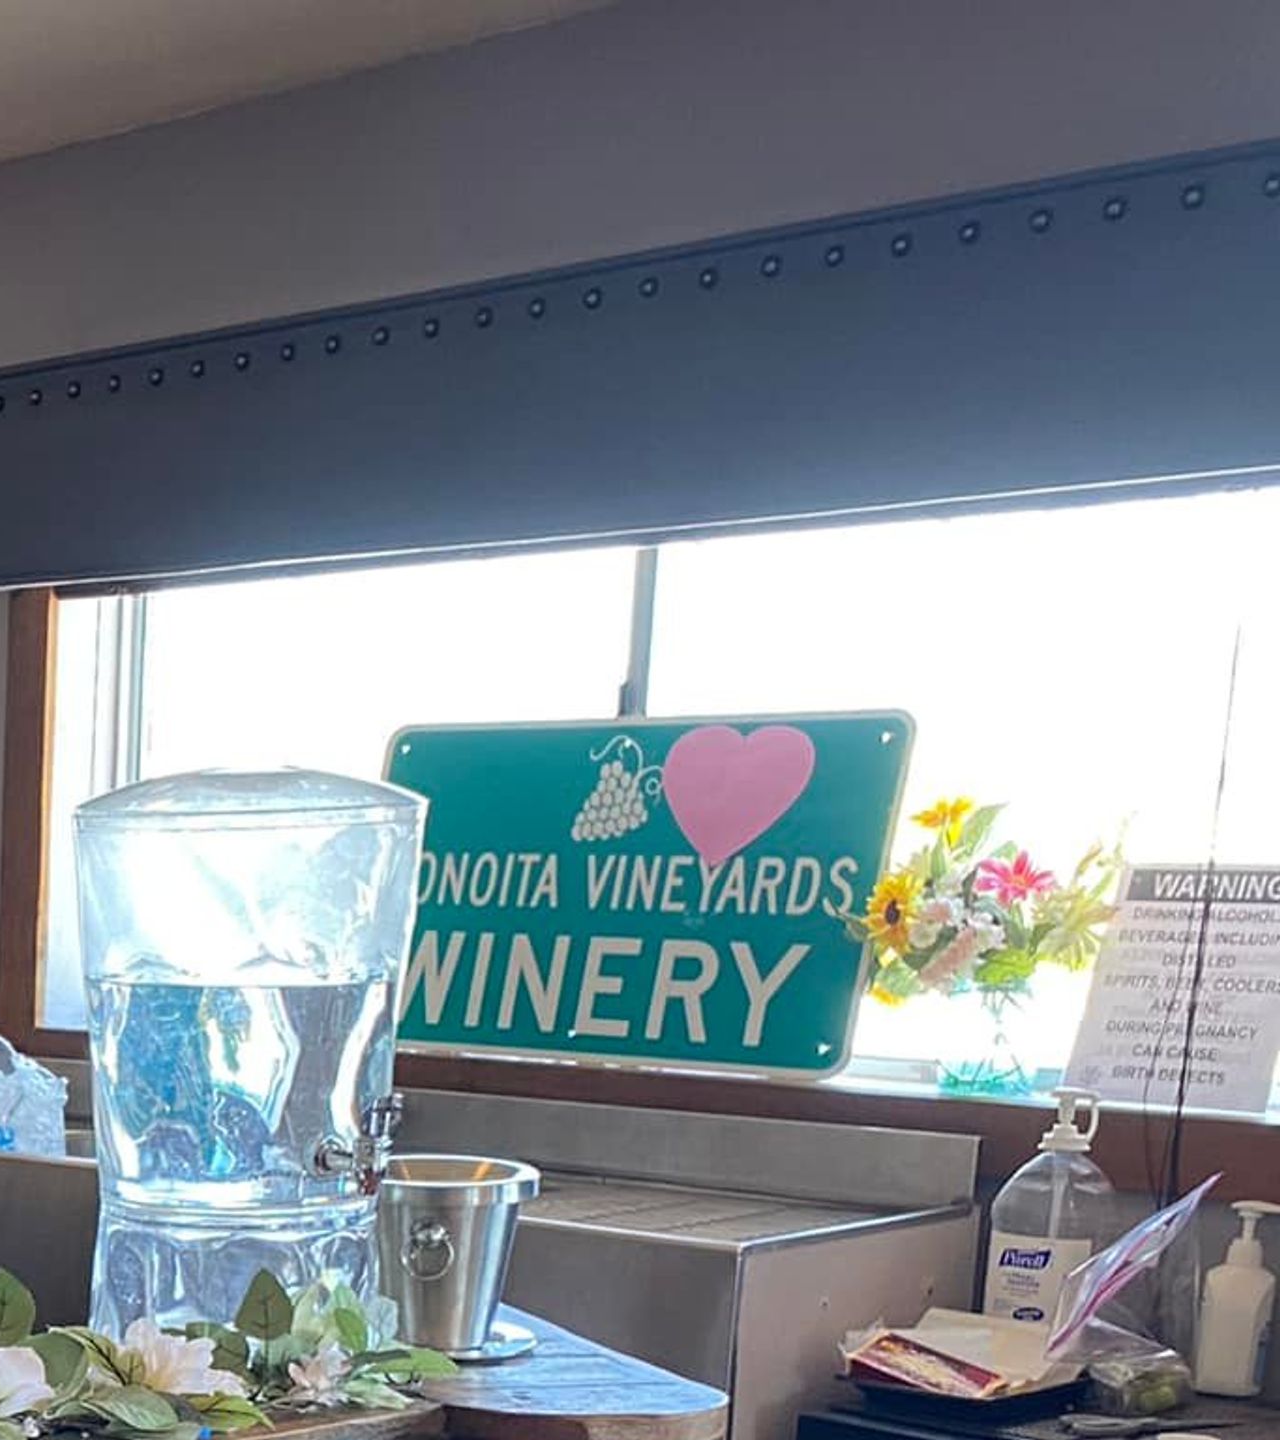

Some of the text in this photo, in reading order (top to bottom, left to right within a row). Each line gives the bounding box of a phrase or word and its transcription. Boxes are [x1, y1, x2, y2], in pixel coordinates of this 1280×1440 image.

[417, 851, 860, 917] ONOITA VINEYARDS
[398, 930, 811, 1047] WINERY
